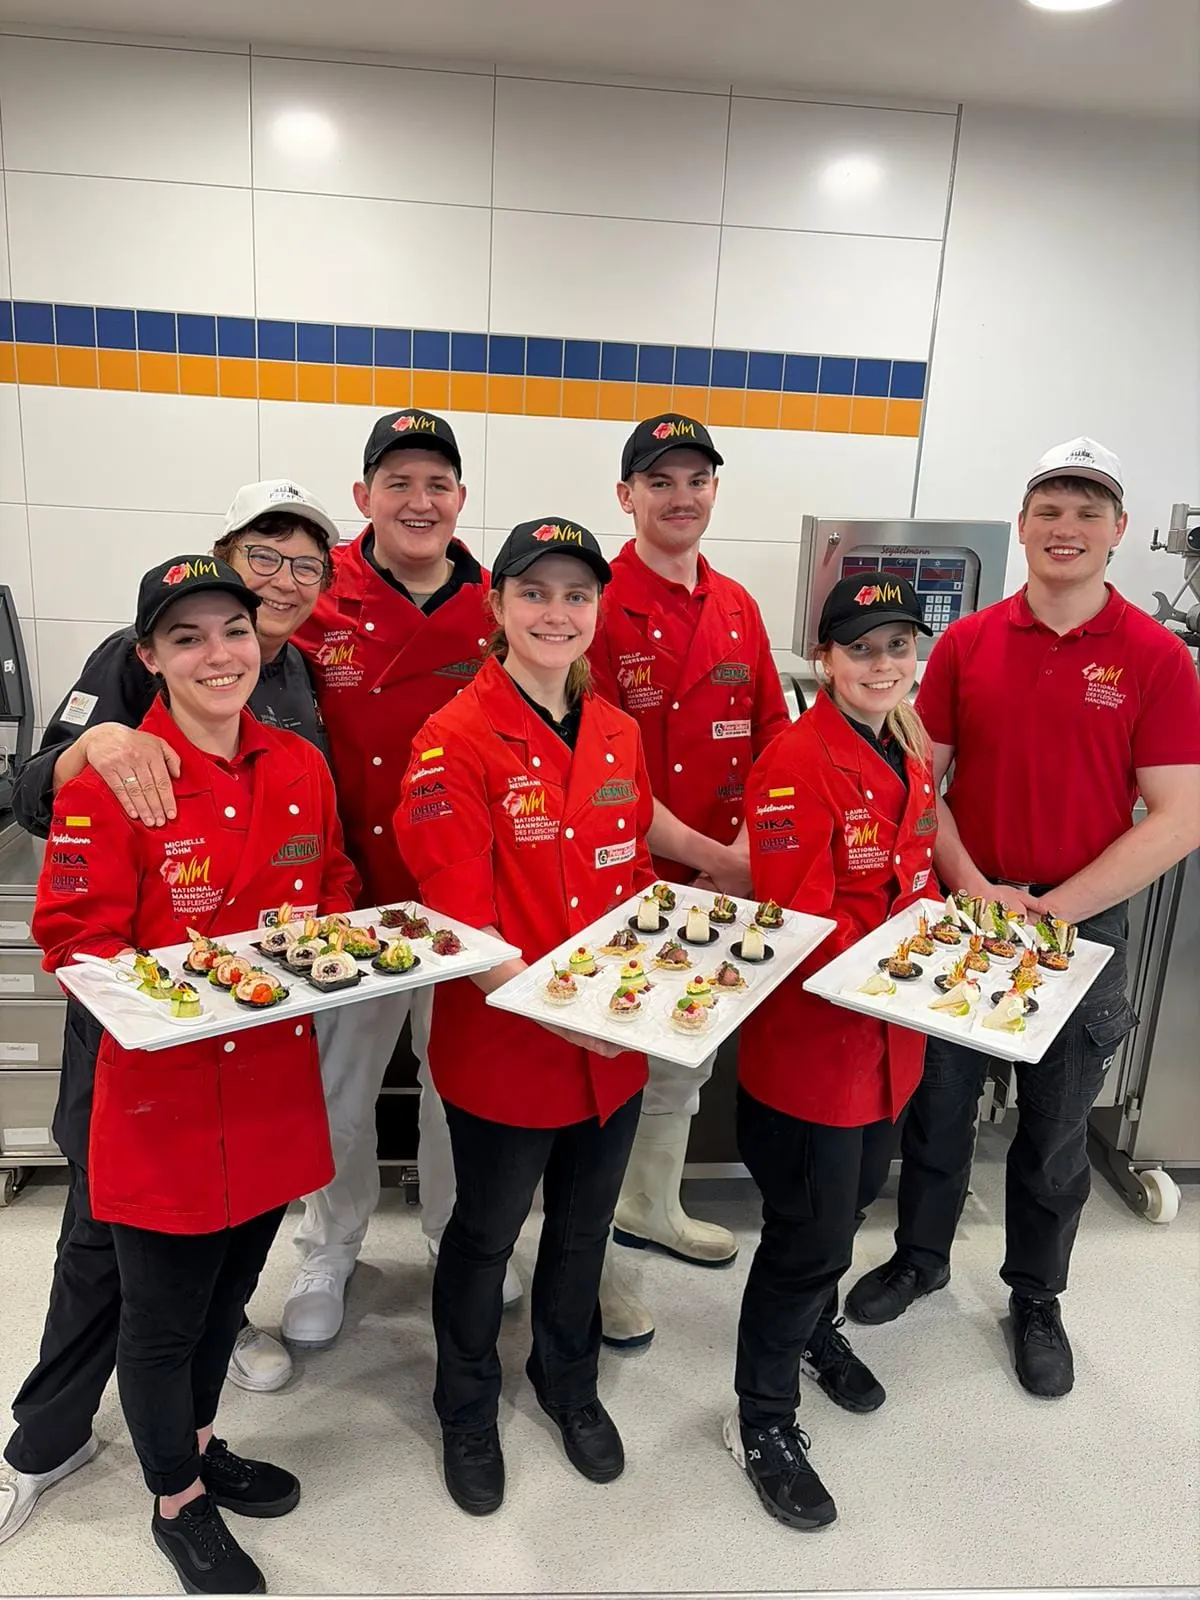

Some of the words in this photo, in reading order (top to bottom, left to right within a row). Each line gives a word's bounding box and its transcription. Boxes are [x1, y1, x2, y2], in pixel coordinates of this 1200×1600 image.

[880, 545, 931, 556] Seydelmann
[627, 686, 654, 694] NATIONAL
[1088, 682, 1118, 692] NATIONAL
[508, 775, 528, 783] LYNN
[411, 782, 446, 798] SIKA
[845, 808, 868, 816] LAURA
[514, 815, 550, 823] NATIONAL
[514, 820, 560, 829] MANNSCHAFT
[756, 819, 794, 831] SIKA
[528, 827, 559, 835] FLEISCHER
[515, 834, 555, 842] HANDWERKS
[164, 838, 206, 849] MICHELLE
[165, 847, 191, 856] BÖHM
[848, 850, 890, 859] MANNSCHAFT
[52, 852, 87, 864] SIKA
[171, 885, 213, 893] NATIONAL
[171, 888, 224, 899] MANNSCHAFT
[187, 896, 222, 906] FLEISCHER
[173, 904, 218, 913] HANDWERKS
